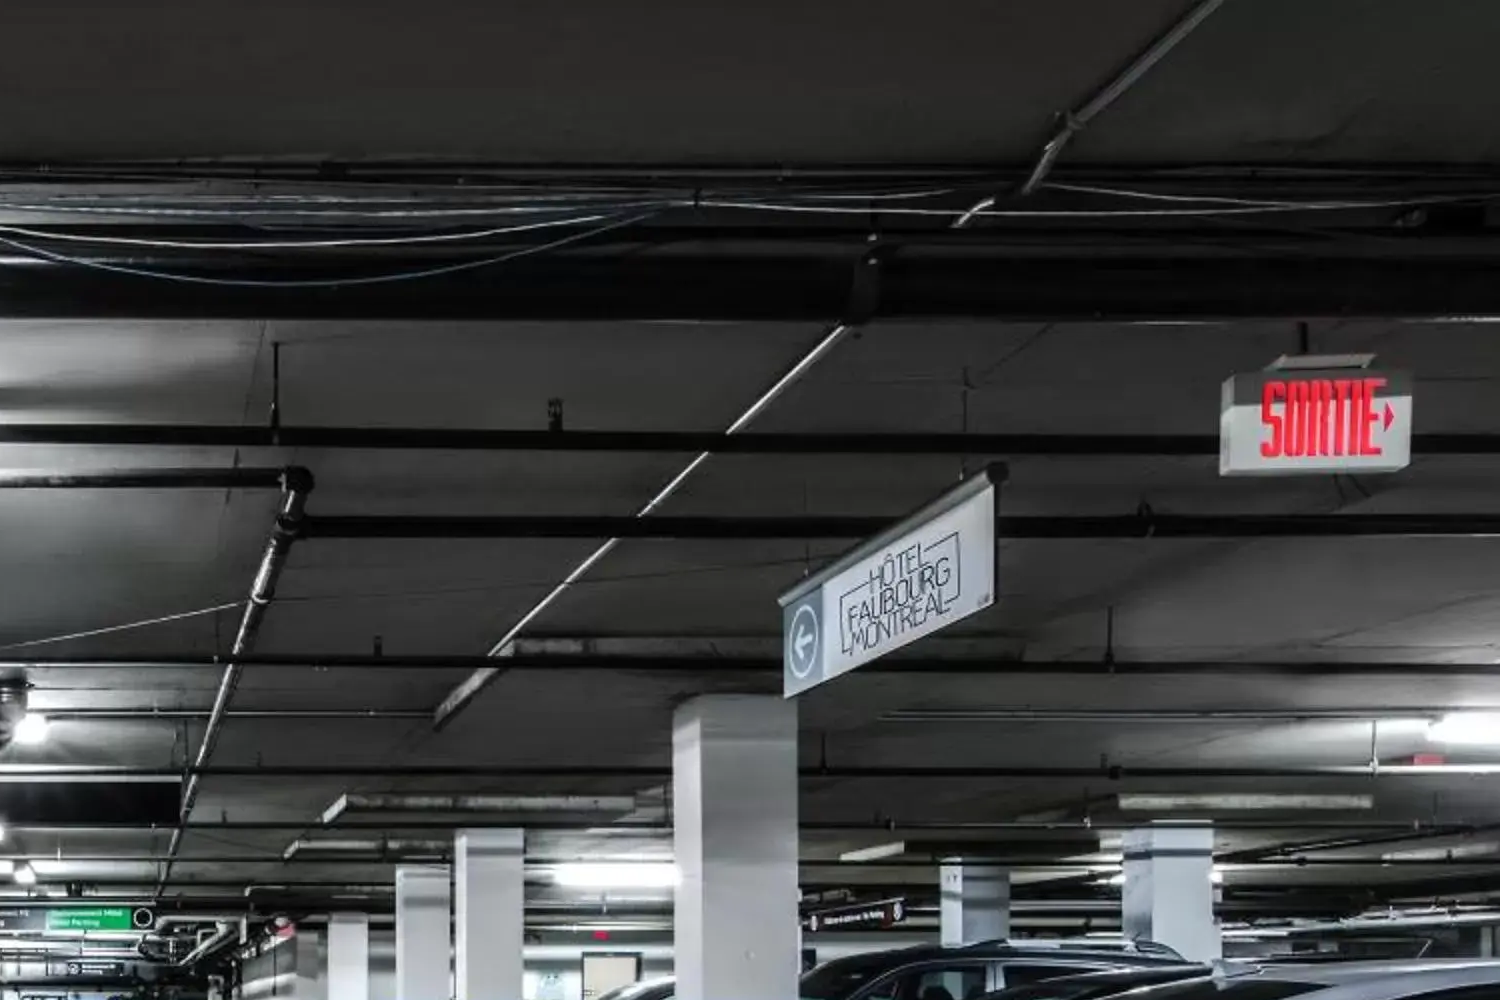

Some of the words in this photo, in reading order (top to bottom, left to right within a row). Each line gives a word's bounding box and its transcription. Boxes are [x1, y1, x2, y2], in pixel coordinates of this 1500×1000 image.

[1260, 378, 1387, 457] SORTIE
[849, 556, 951, 634] FAUBOURG
[869, 541, 930, 594] HÔTEL
